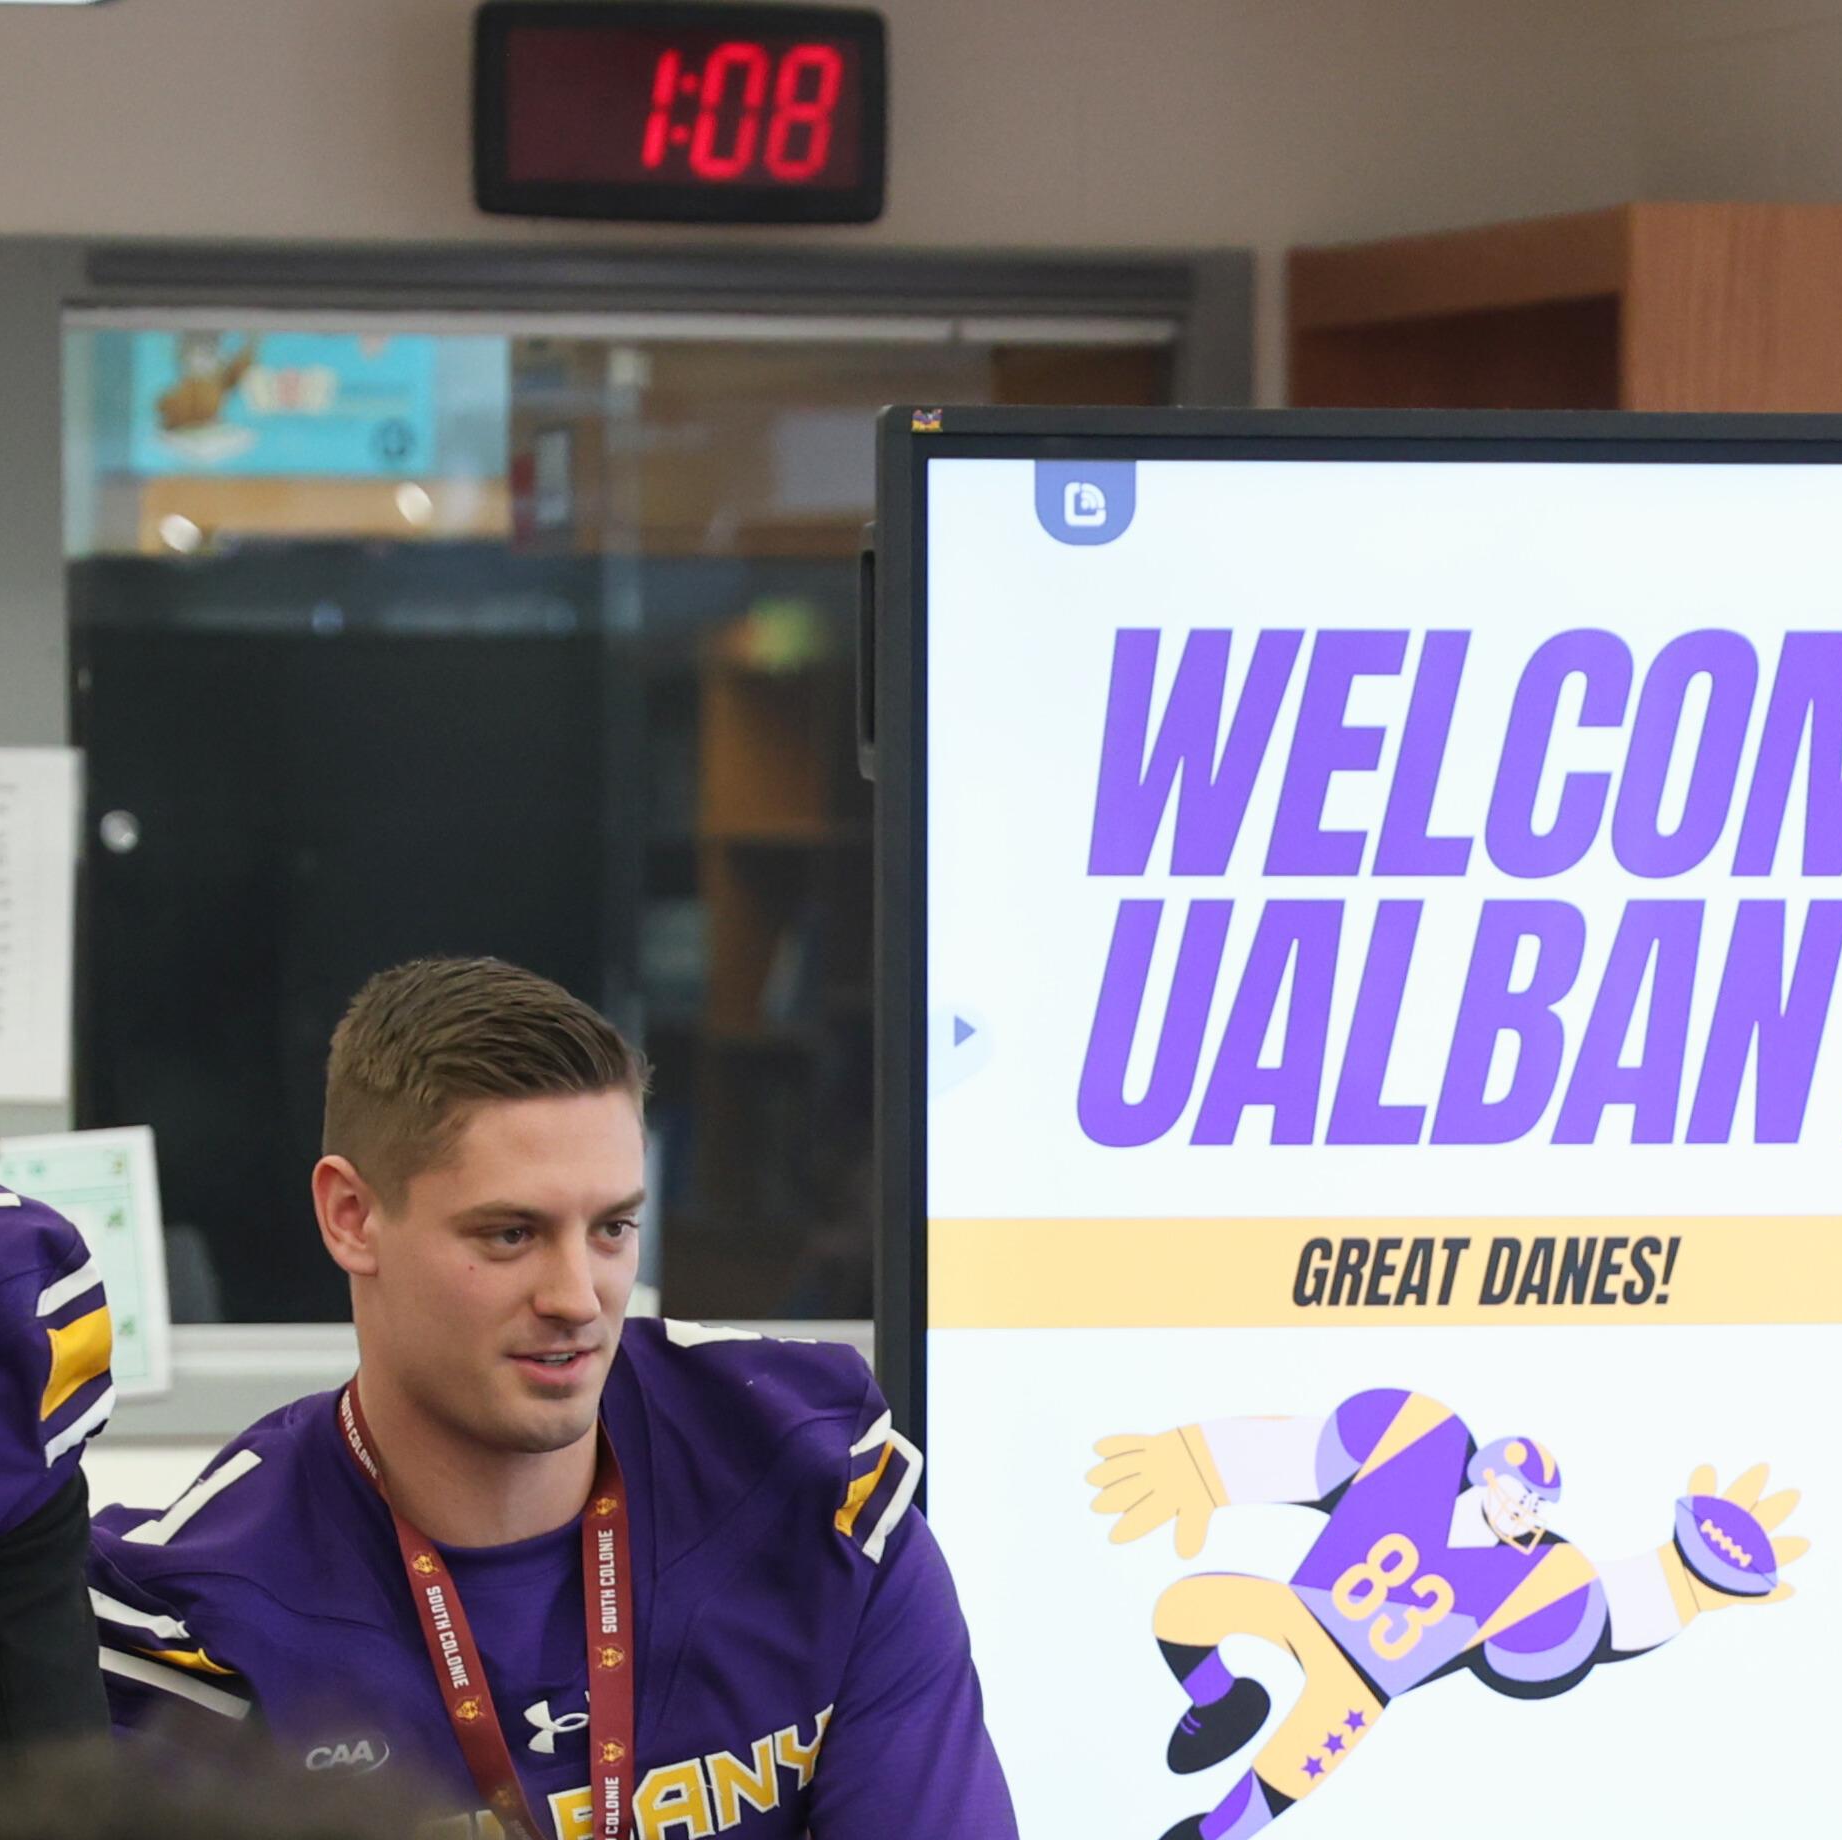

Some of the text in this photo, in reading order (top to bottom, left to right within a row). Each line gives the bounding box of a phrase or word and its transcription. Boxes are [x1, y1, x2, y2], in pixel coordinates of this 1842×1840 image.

[641, 43, 844, 182] 1:08
[1293, 1237, 1680, 1307] GREAT DANES!
[598, 1529, 618, 1634] SOUTH COLONIE
[1331, 1532, 1456, 1662] 83
[426, 1585, 470, 1690] SOUTH COLONIE
[306, 1740, 374, 1771] CAA
[605, 1776, 619, 1835] COLONIE
